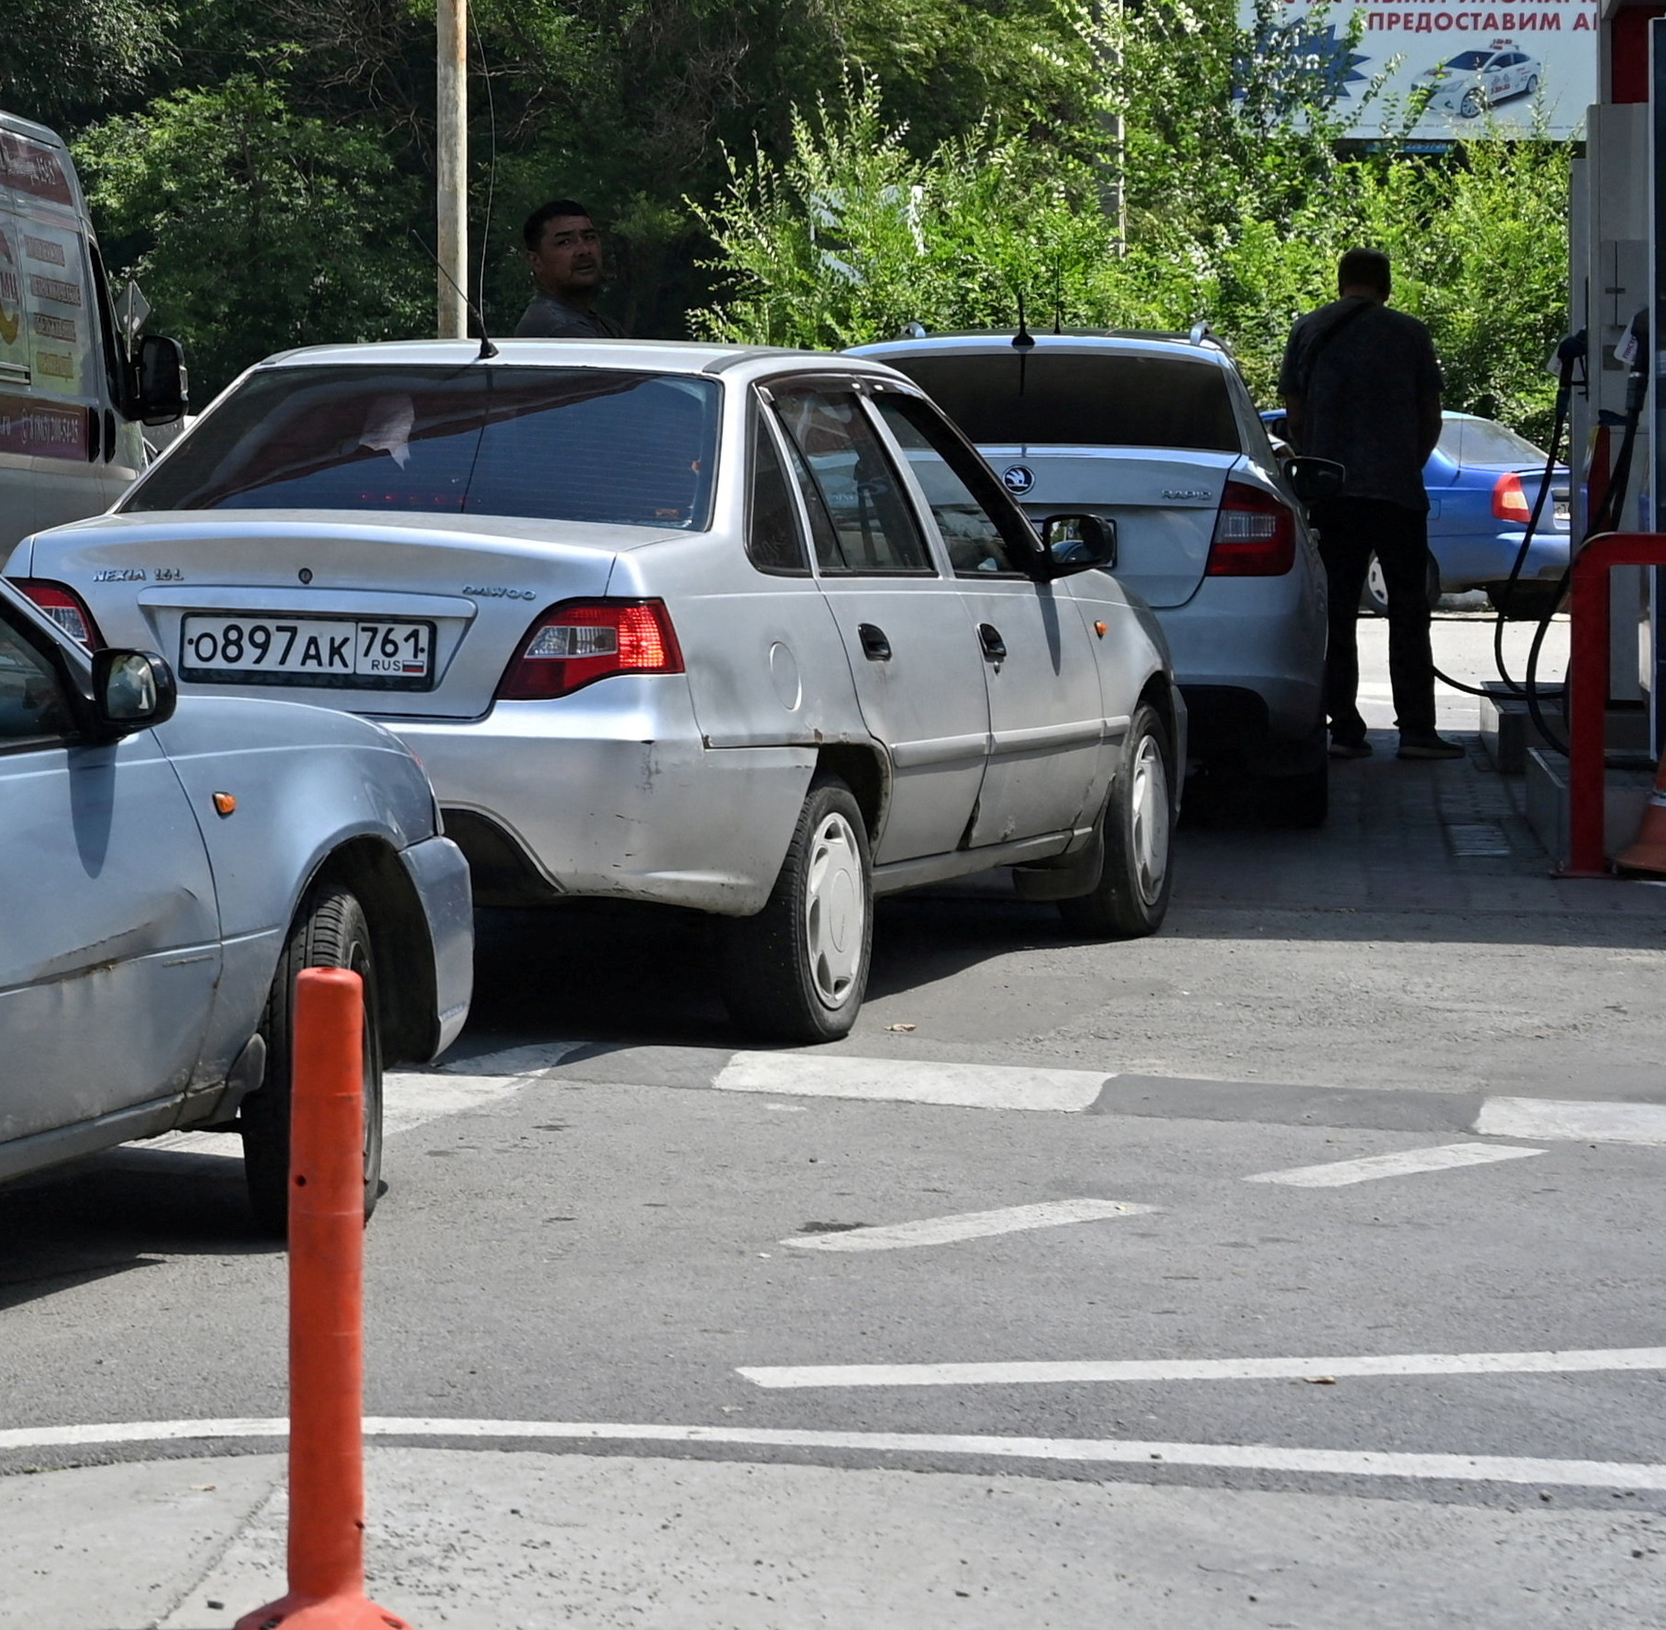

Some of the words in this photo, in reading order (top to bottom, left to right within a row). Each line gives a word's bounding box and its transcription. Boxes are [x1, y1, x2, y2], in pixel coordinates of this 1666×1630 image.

[1368, 12, 1562, 34] ПРЕДОСТАВИМ
[1572, 12, 1598, 32] А
[1160, 488, 1213, 501] RAPID
[92, 567, 147, 583] NEXIA
[193, 623, 352, 669] О897АК
[359, 625, 421, 660] 761
[370, 659, 402, 673] RUS
